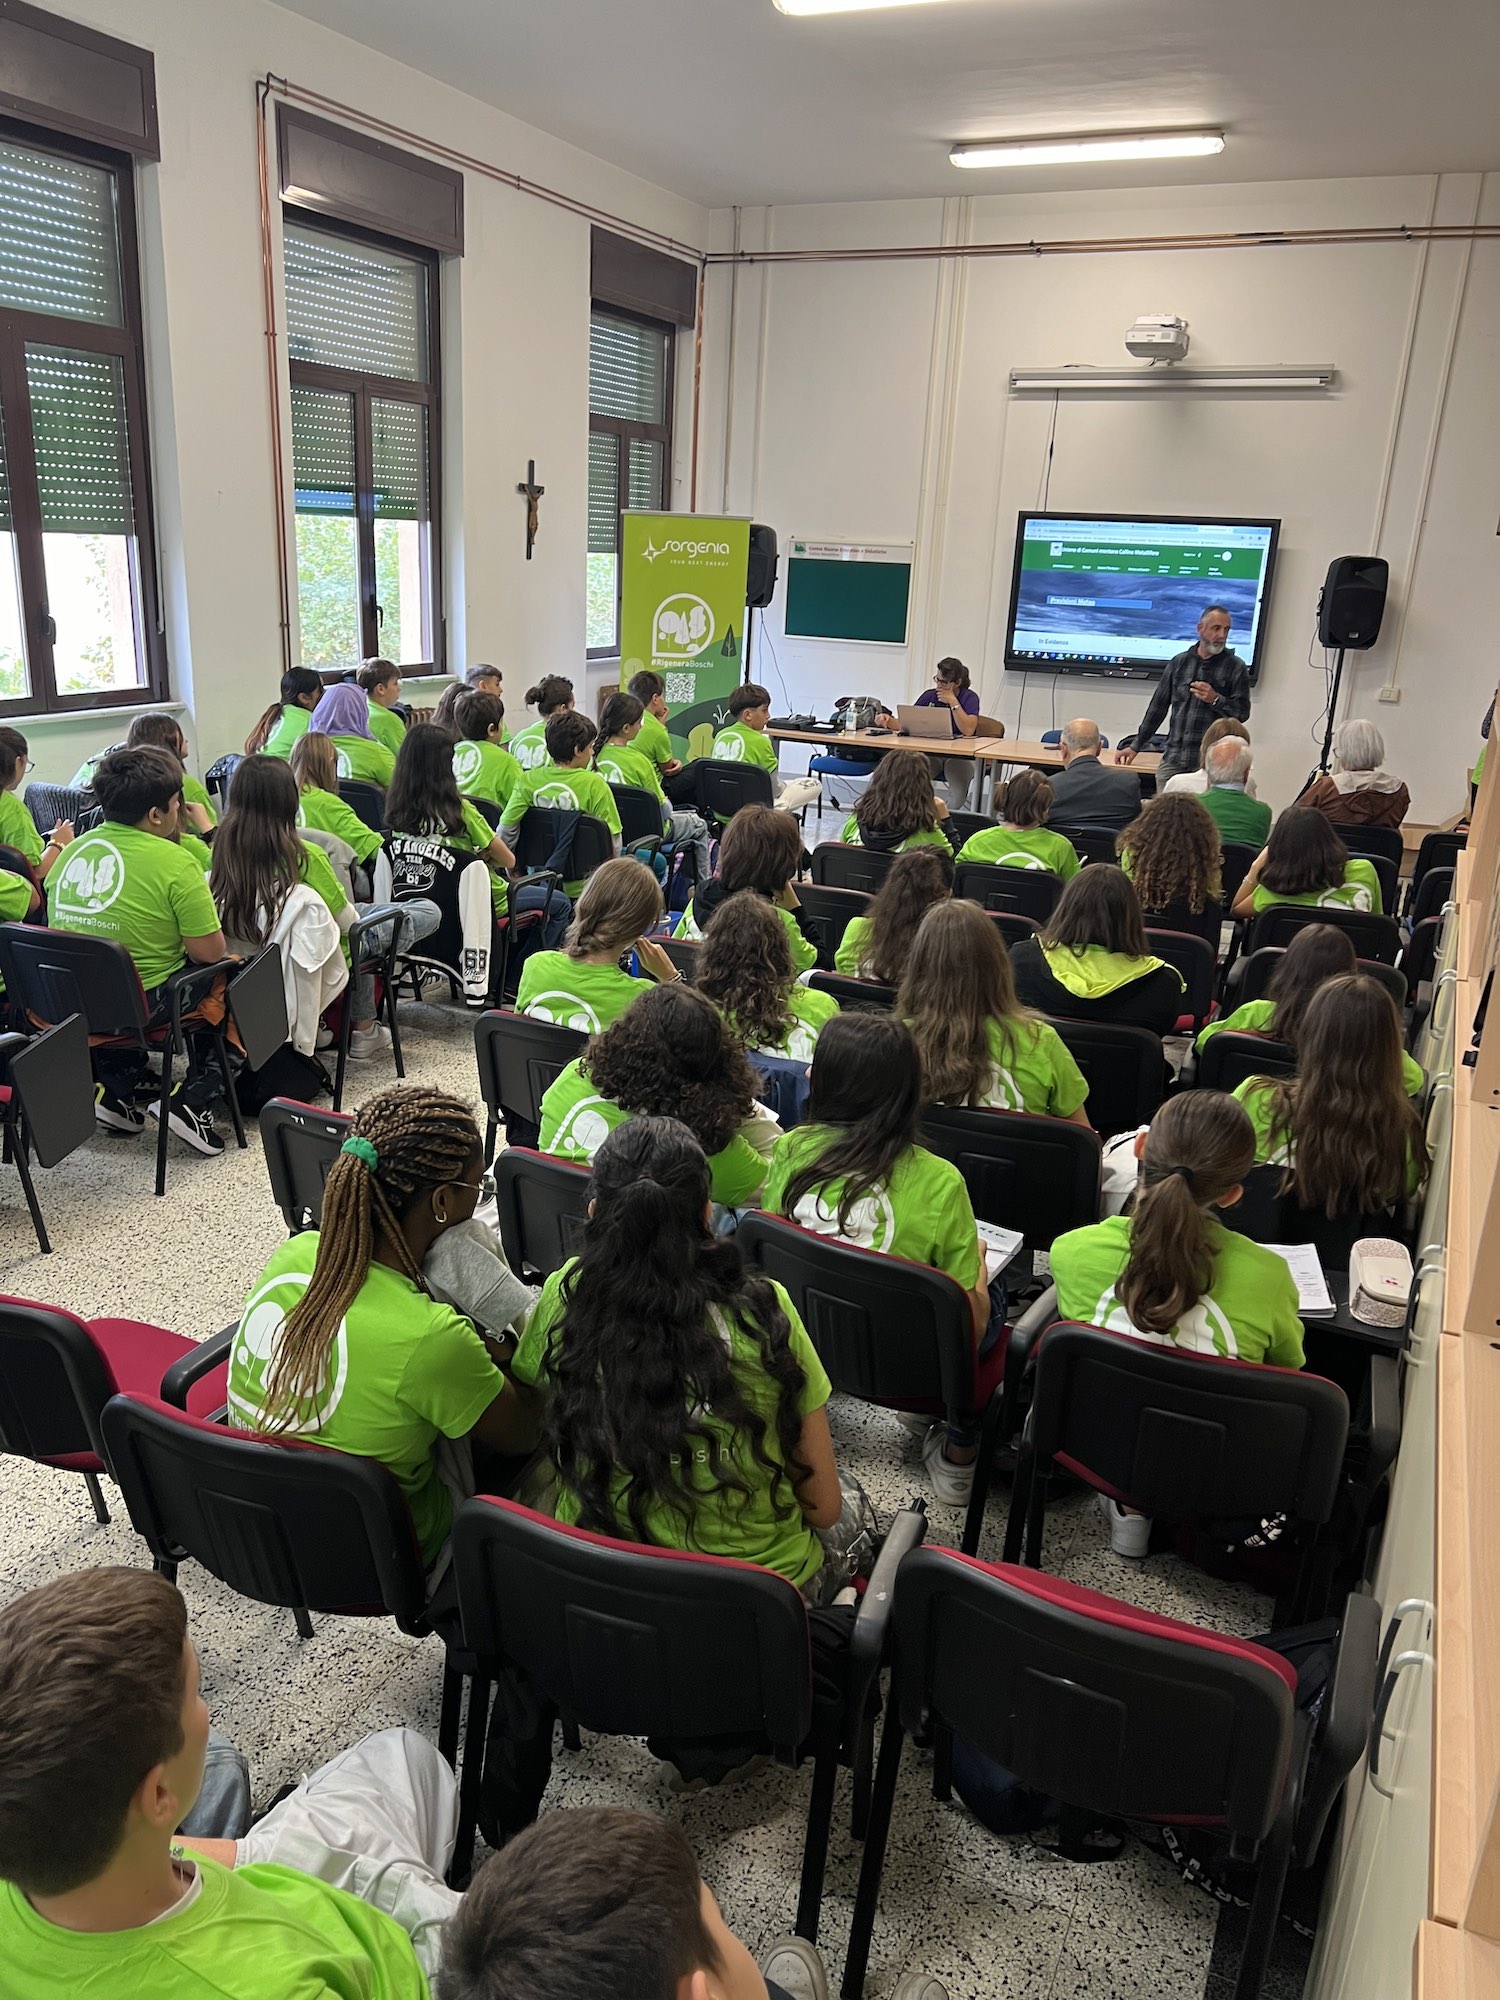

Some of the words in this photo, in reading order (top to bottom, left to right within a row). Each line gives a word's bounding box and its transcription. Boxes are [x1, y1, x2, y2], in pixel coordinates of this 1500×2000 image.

[661, 540, 730, 558] sorgenia
[1045, 638, 1069, 646] Evidenza
[651, 659, 714, 668] #RigeneraBoschi
[403, 840, 456, 872] ANGELES
[405, 854, 424, 864] TEAM
[55, 911, 120, 931] #RigeneraBoschi
